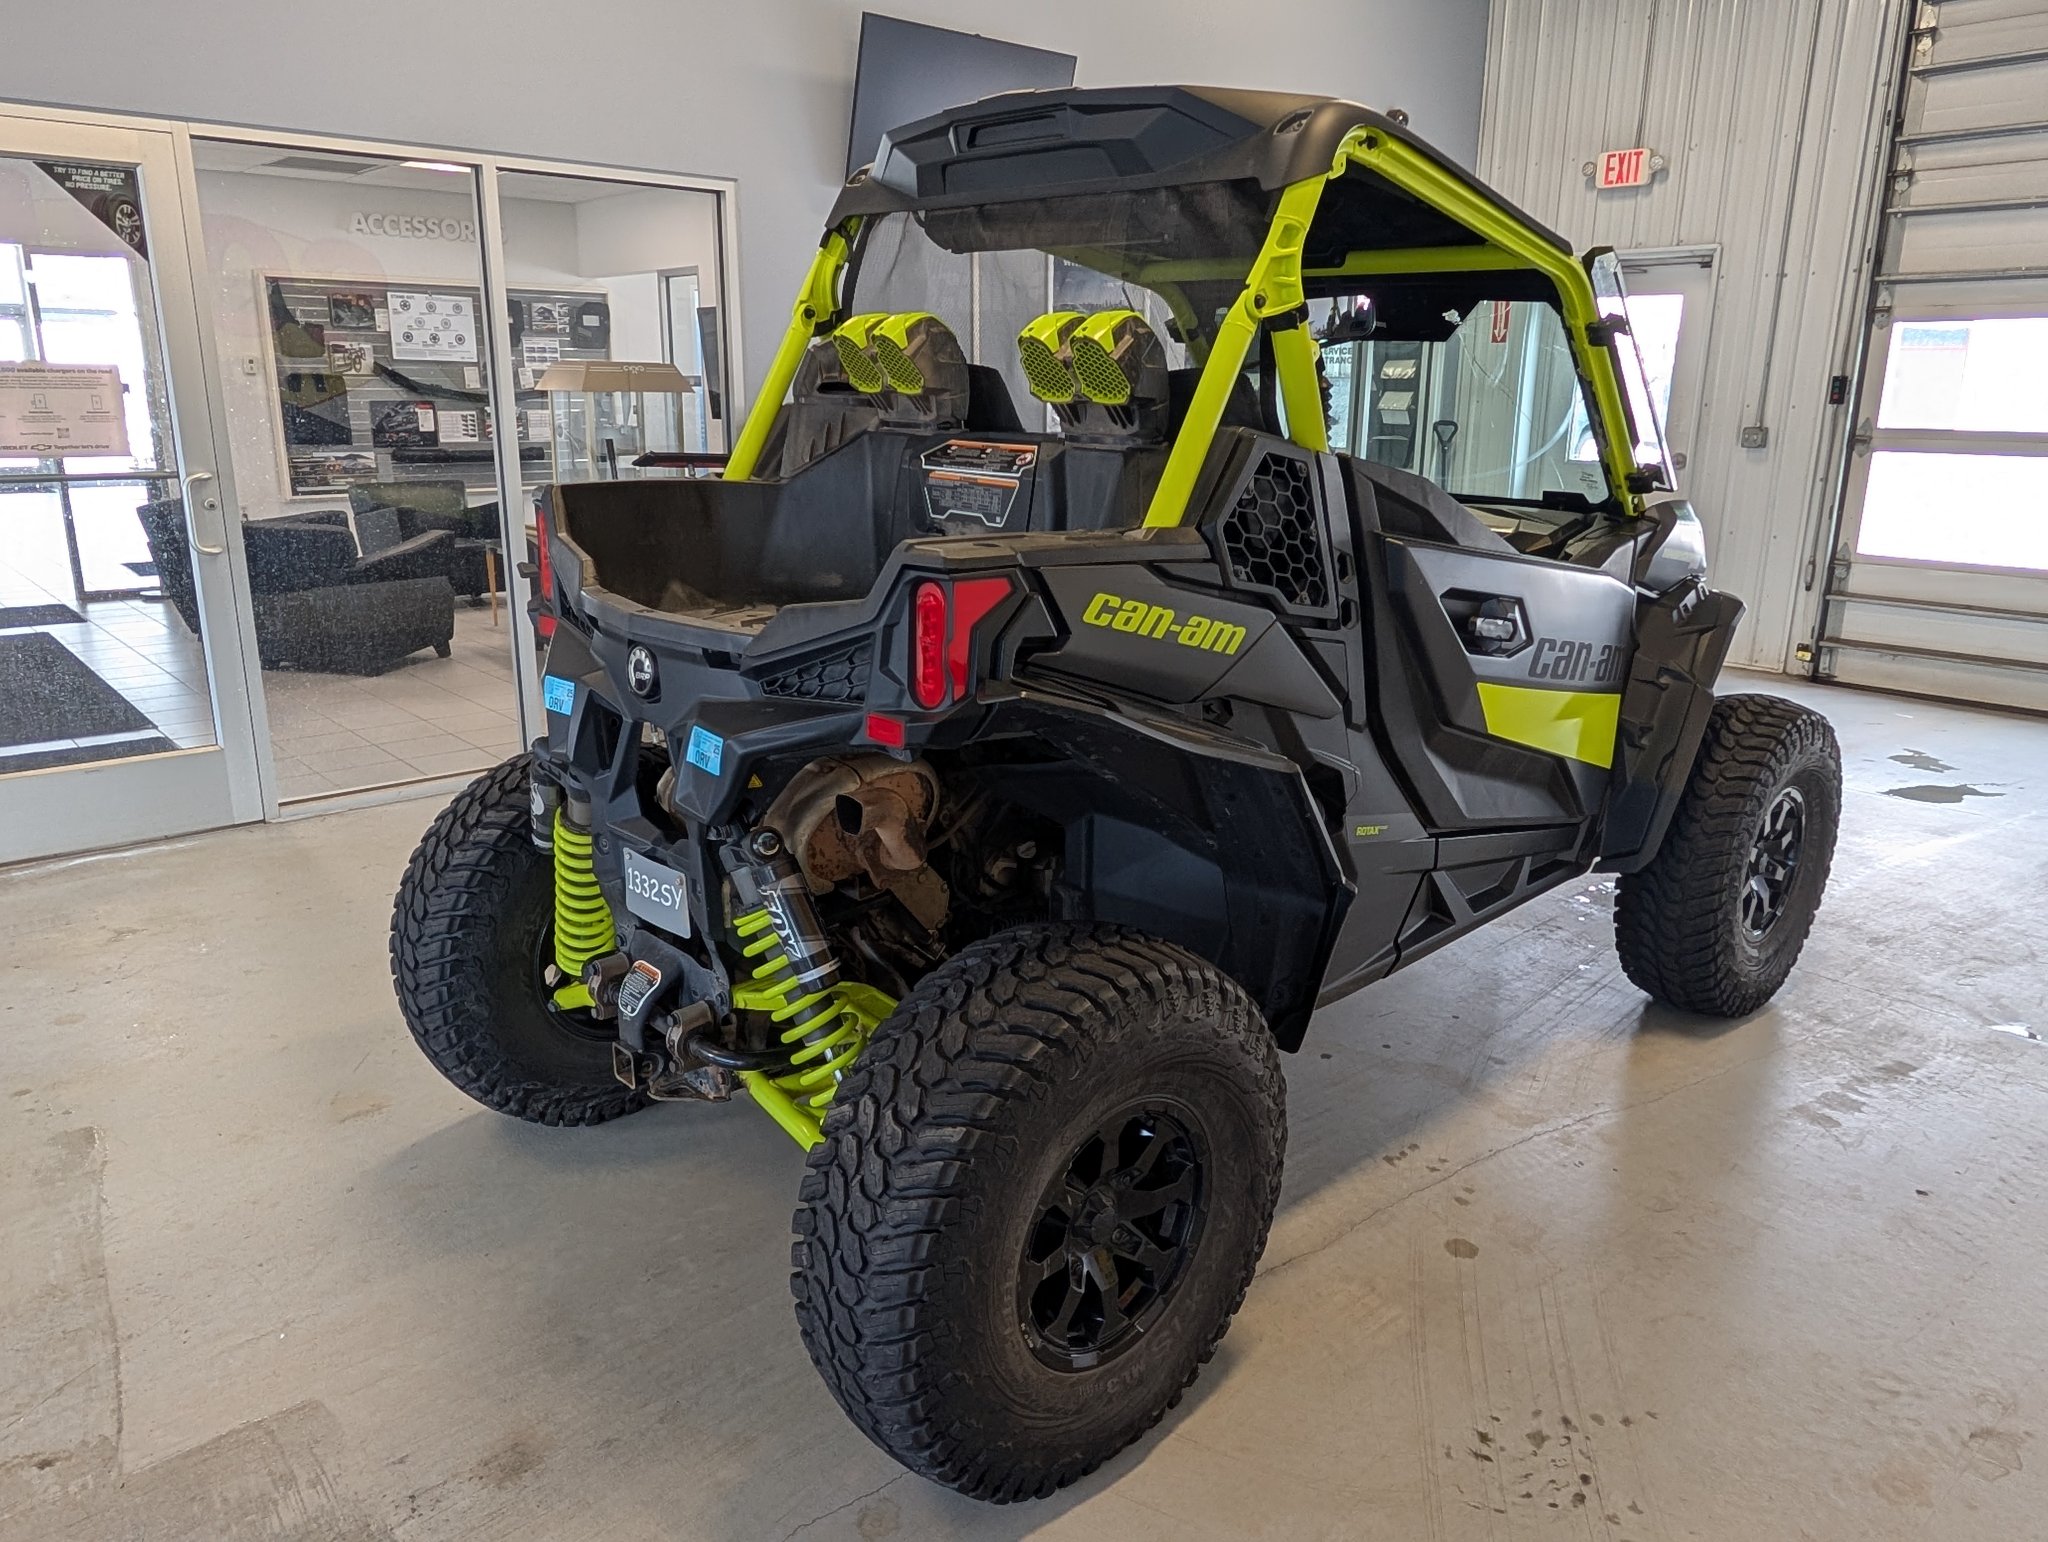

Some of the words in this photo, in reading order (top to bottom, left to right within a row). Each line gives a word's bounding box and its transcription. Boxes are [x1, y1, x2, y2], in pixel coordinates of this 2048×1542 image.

[53, 166, 67, 174] TRY
[100, 171, 125, 179] BETTER
[1603, 151, 1643, 185] EXIT
[71, 175, 91, 183] PRICE
[350, 210, 508, 244] ACCESSOR
[1323, 347, 1353, 355] ERVICE
[1325, 356, 1353, 365] TRANC
[635, 671, 651, 681] BRP
[549, 695, 565, 711] ORV
[695, 749, 711, 769] ORV
[627, 867, 683, 910] 1332SY
